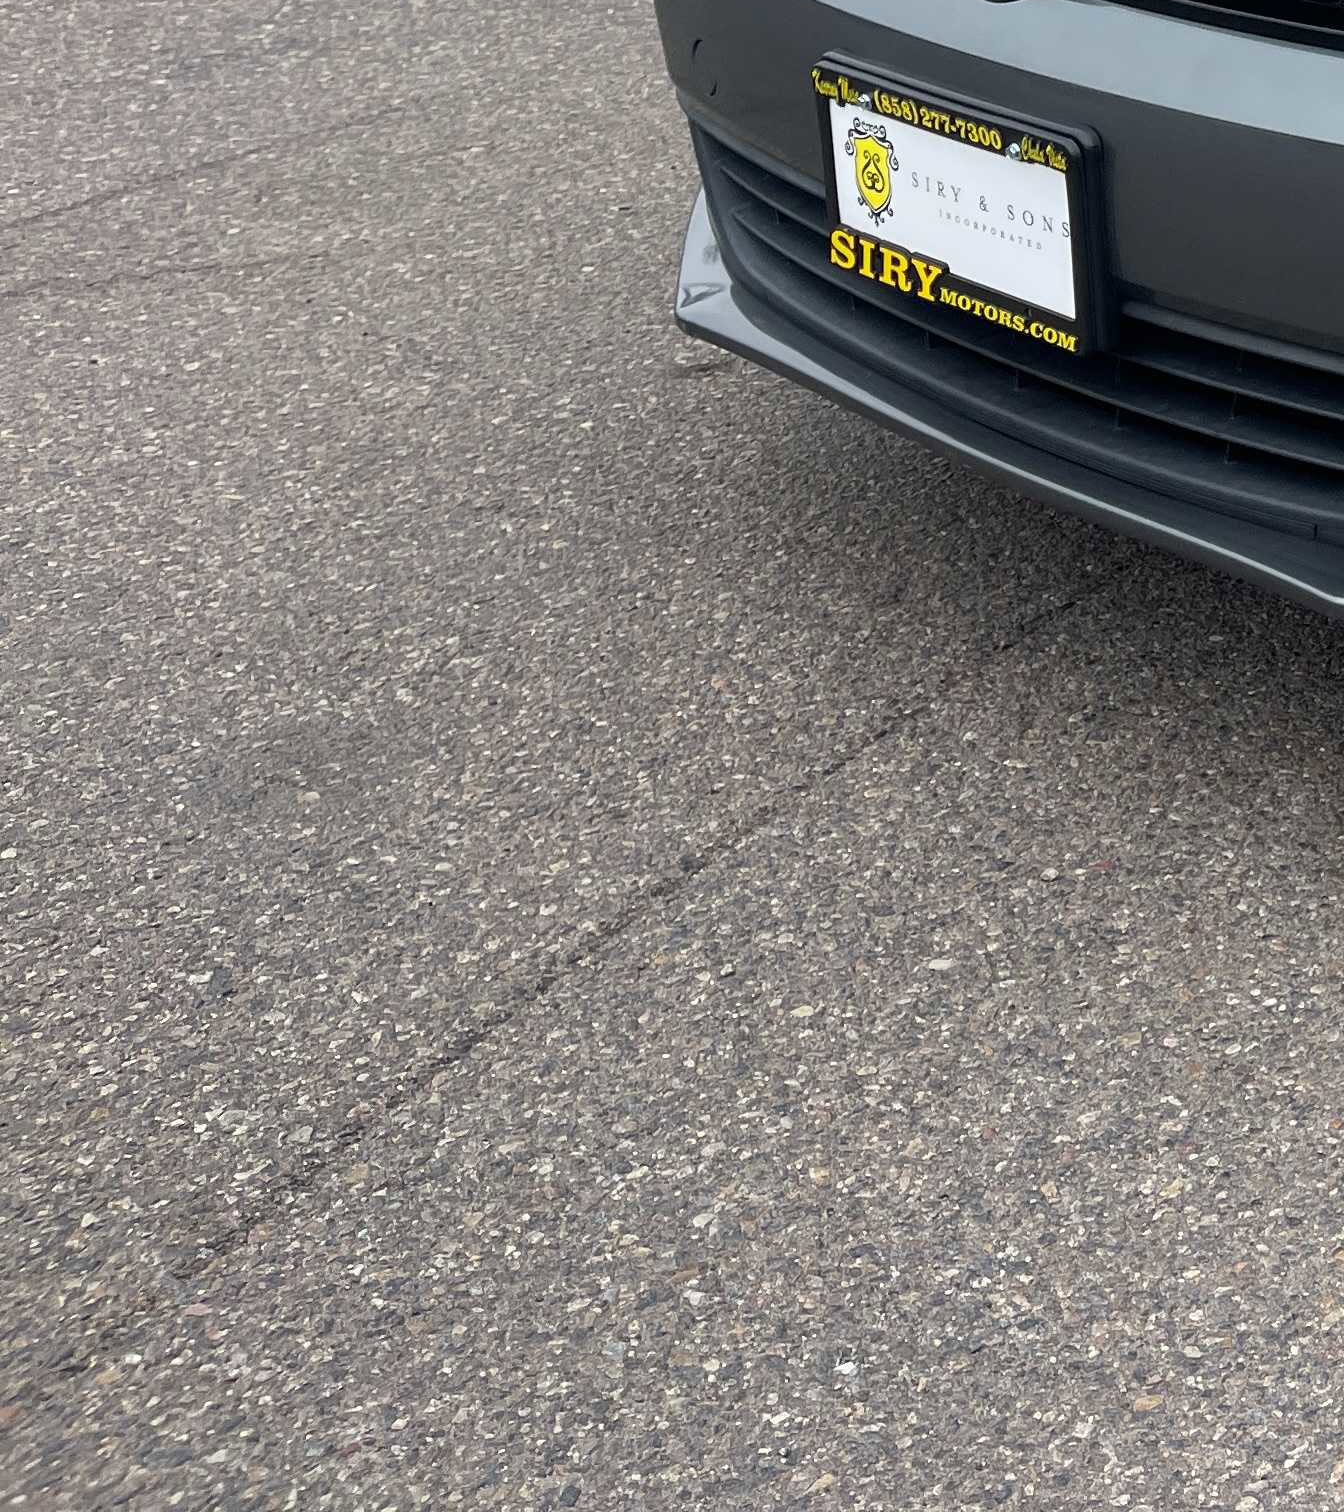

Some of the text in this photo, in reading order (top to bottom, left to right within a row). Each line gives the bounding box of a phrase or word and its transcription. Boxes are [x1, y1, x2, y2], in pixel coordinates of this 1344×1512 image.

[873, 88, 1003, 150] (858) 277-7300
[911, 171, 1072, 239] SIRY & SONS
[938, 208, 1043, 251] INCORPORATED
